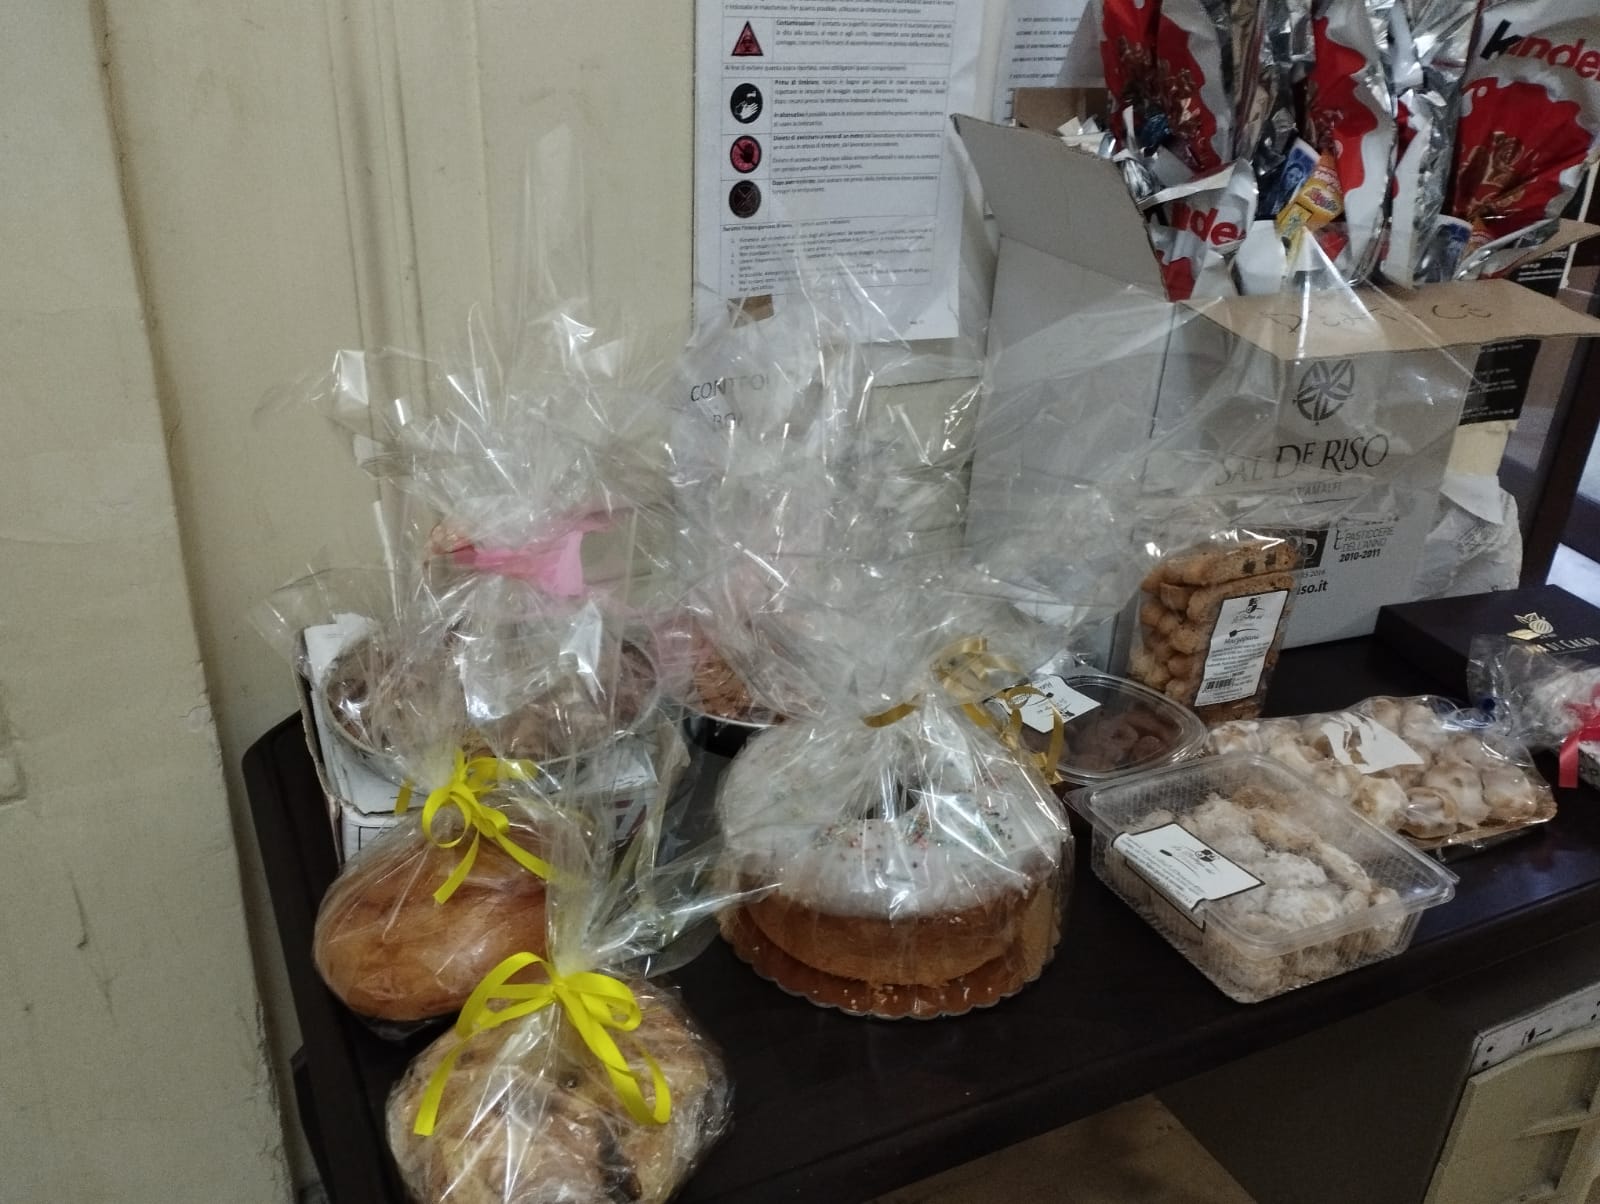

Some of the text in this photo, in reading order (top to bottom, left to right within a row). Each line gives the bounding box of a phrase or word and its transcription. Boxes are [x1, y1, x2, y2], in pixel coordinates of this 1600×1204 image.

[1273, 442, 1317, 479] DE
[1321, 433, 1390, 473] RISO
[1339, 548, 1381, 562] 2010-2011
